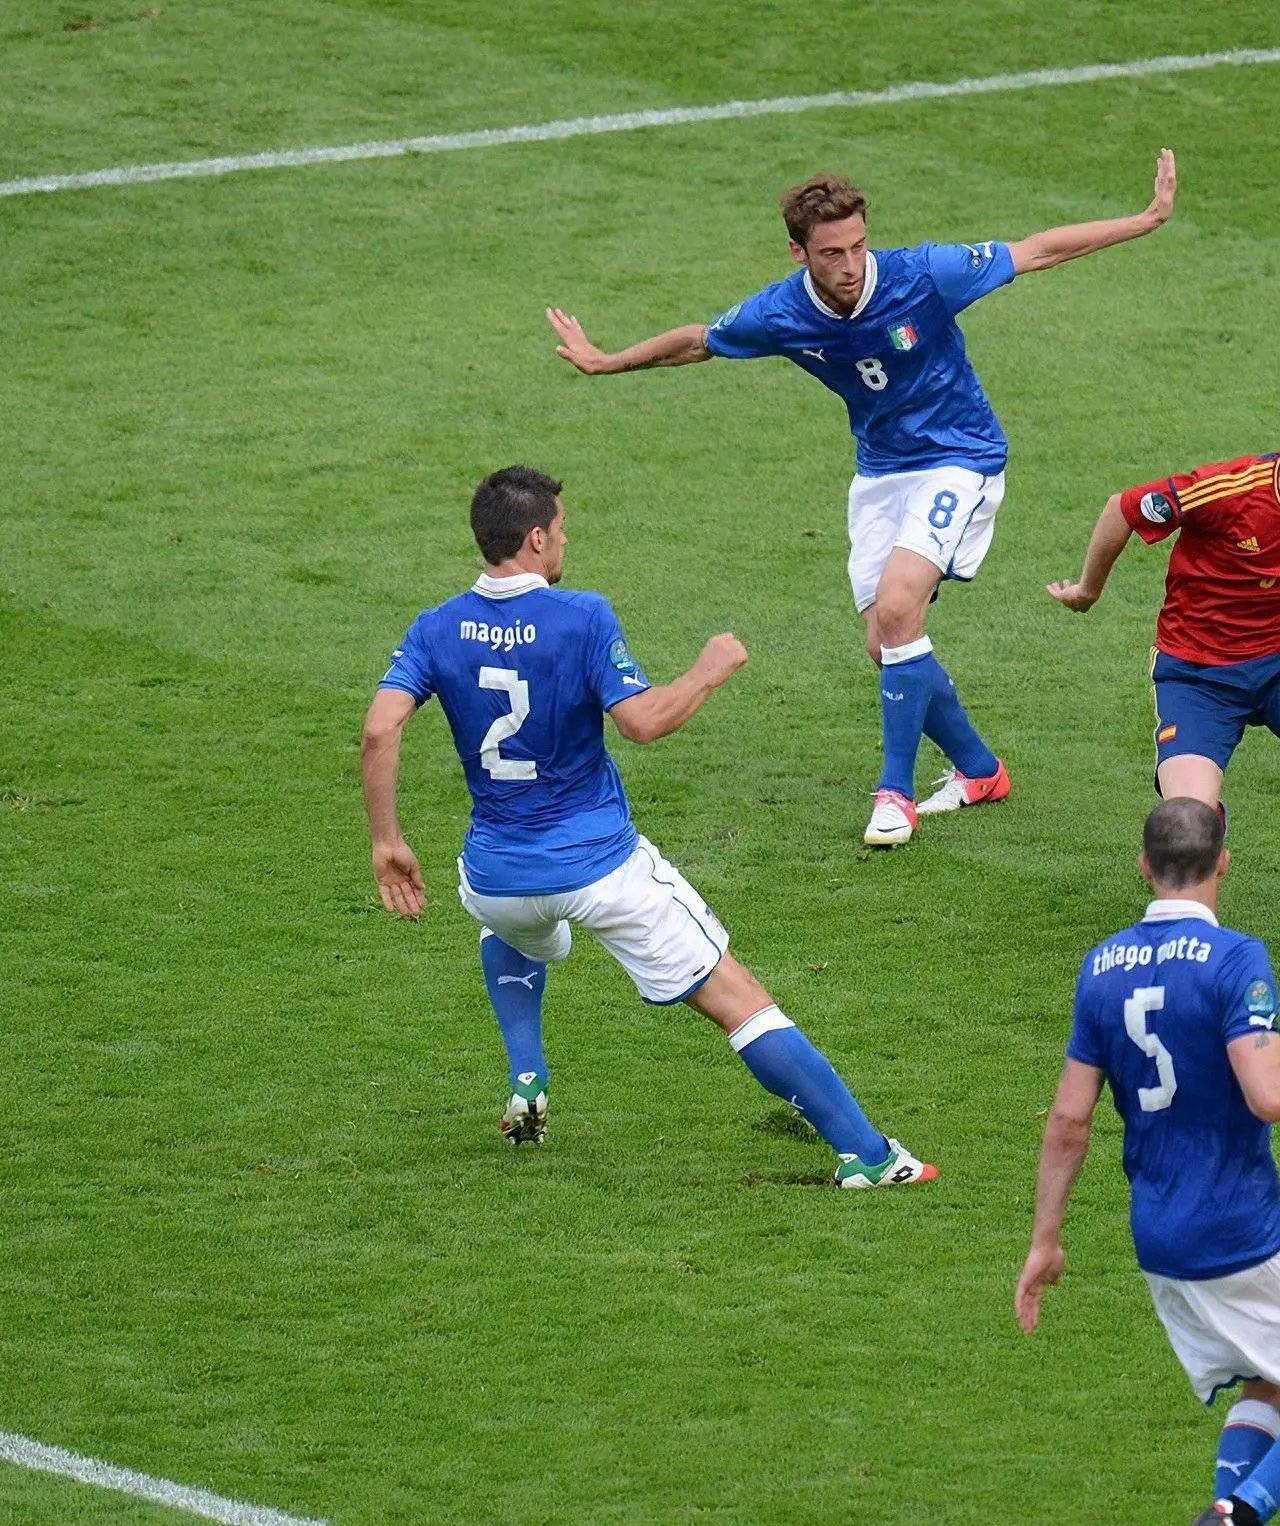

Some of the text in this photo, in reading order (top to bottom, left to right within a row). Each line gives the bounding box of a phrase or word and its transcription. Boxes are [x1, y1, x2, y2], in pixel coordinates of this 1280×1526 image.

[855, 358, 889, 391] 8
[927, 489, 959, 529] 8
[460, 619, 536, 652] maggio
[479, 666, 538, 780] 2
[1092, 943, 1153, 976] thiago
[1124, 986, 1178, 1112] 5
